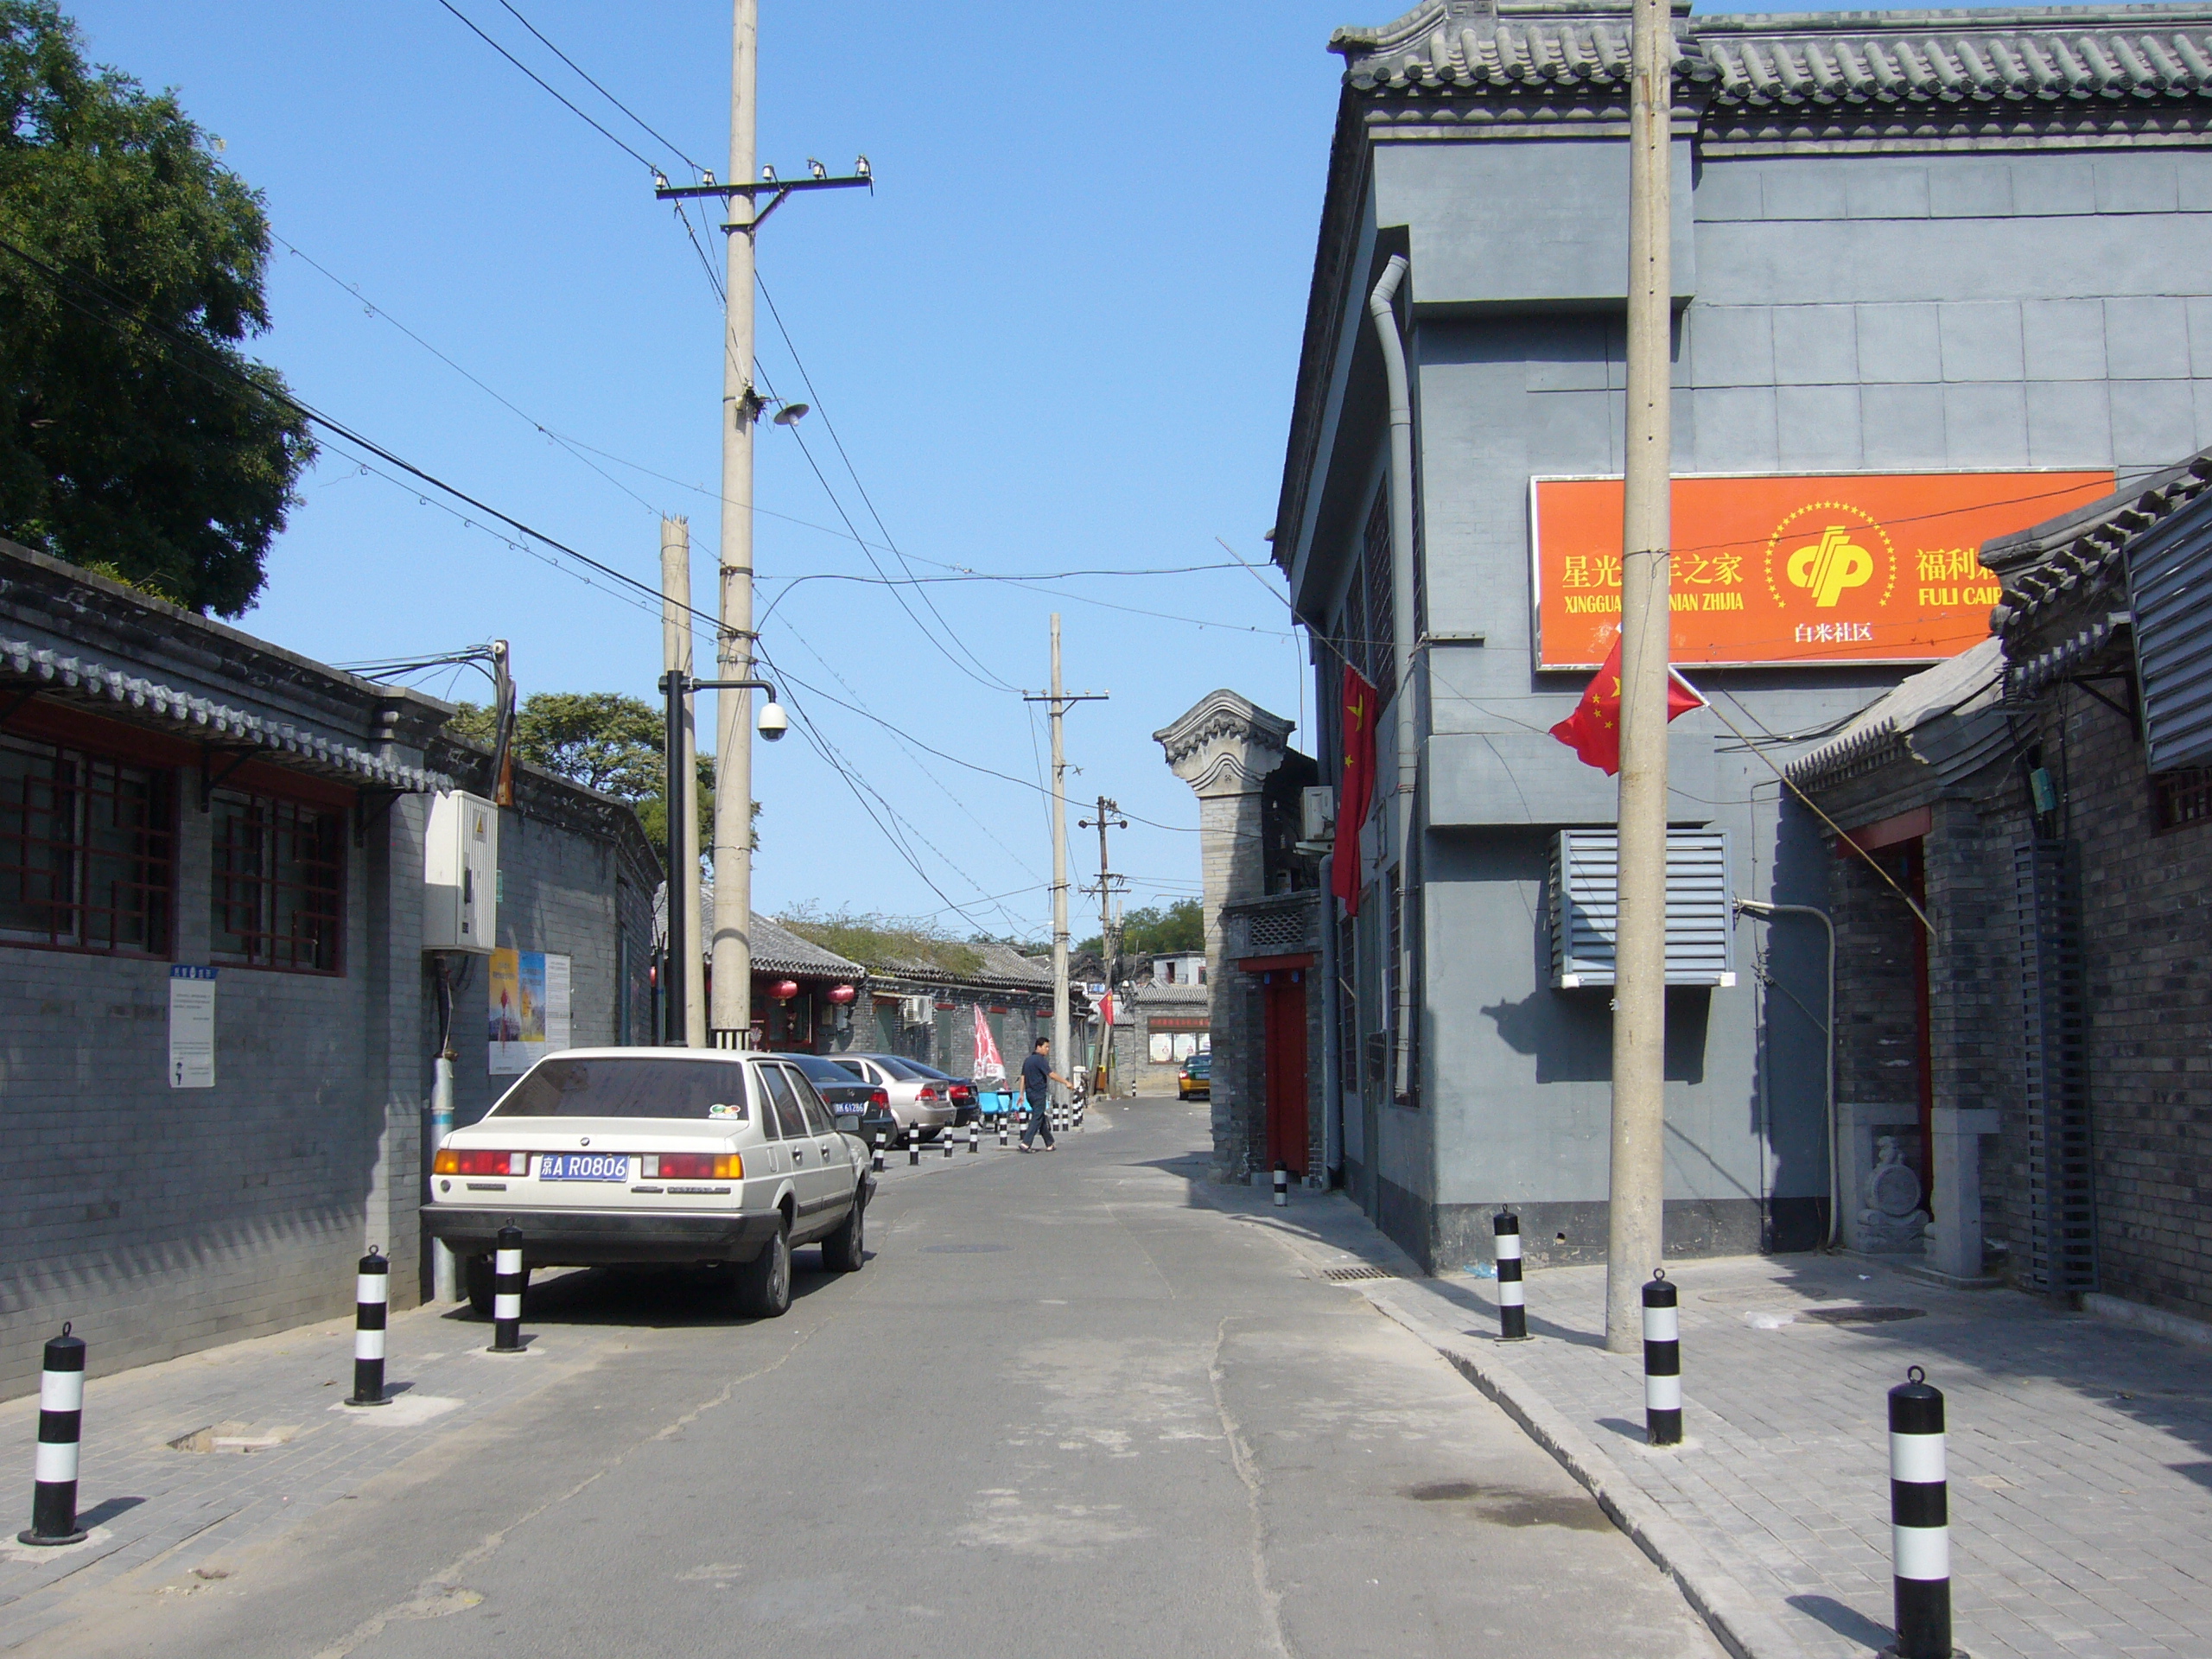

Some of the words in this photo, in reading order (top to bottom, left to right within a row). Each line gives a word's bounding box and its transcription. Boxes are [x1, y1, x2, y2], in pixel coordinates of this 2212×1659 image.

[1562, 554, 1744, 588] 星光年之家
[1565, 594, 1622, 613] XINGGUA
[1669, 594, 1698, 611] NIAN
[1702, 593, 1744, 611] ZHIJIA
[1919, 587, 1959, 606] FULI
[1962, 586, 2003, 605] CAIP
[1795, 622, 1873, 643] 白米社区
[541, 1156, 563, 1176] 京A
[569, 1157, 626, 1176] R0806
